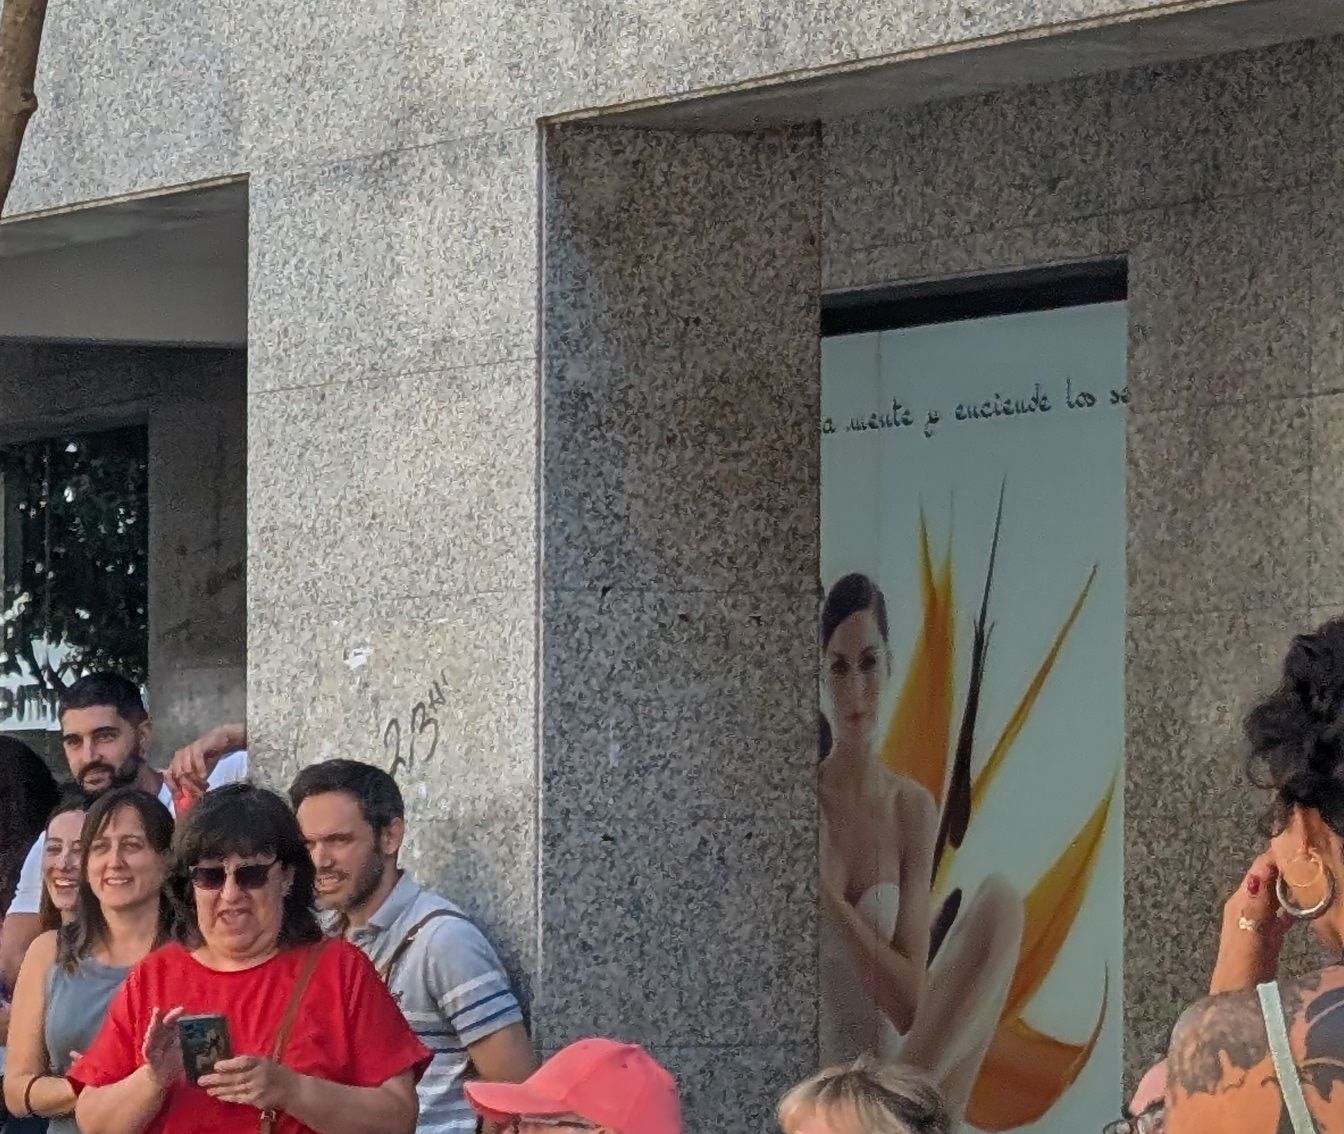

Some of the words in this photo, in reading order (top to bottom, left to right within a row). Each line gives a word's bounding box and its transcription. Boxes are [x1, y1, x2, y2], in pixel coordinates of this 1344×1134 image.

[846, 396, 914, 431] mente
[955, 383, 1052, 421] enciende
[1065, 378, 1097, 409] los
